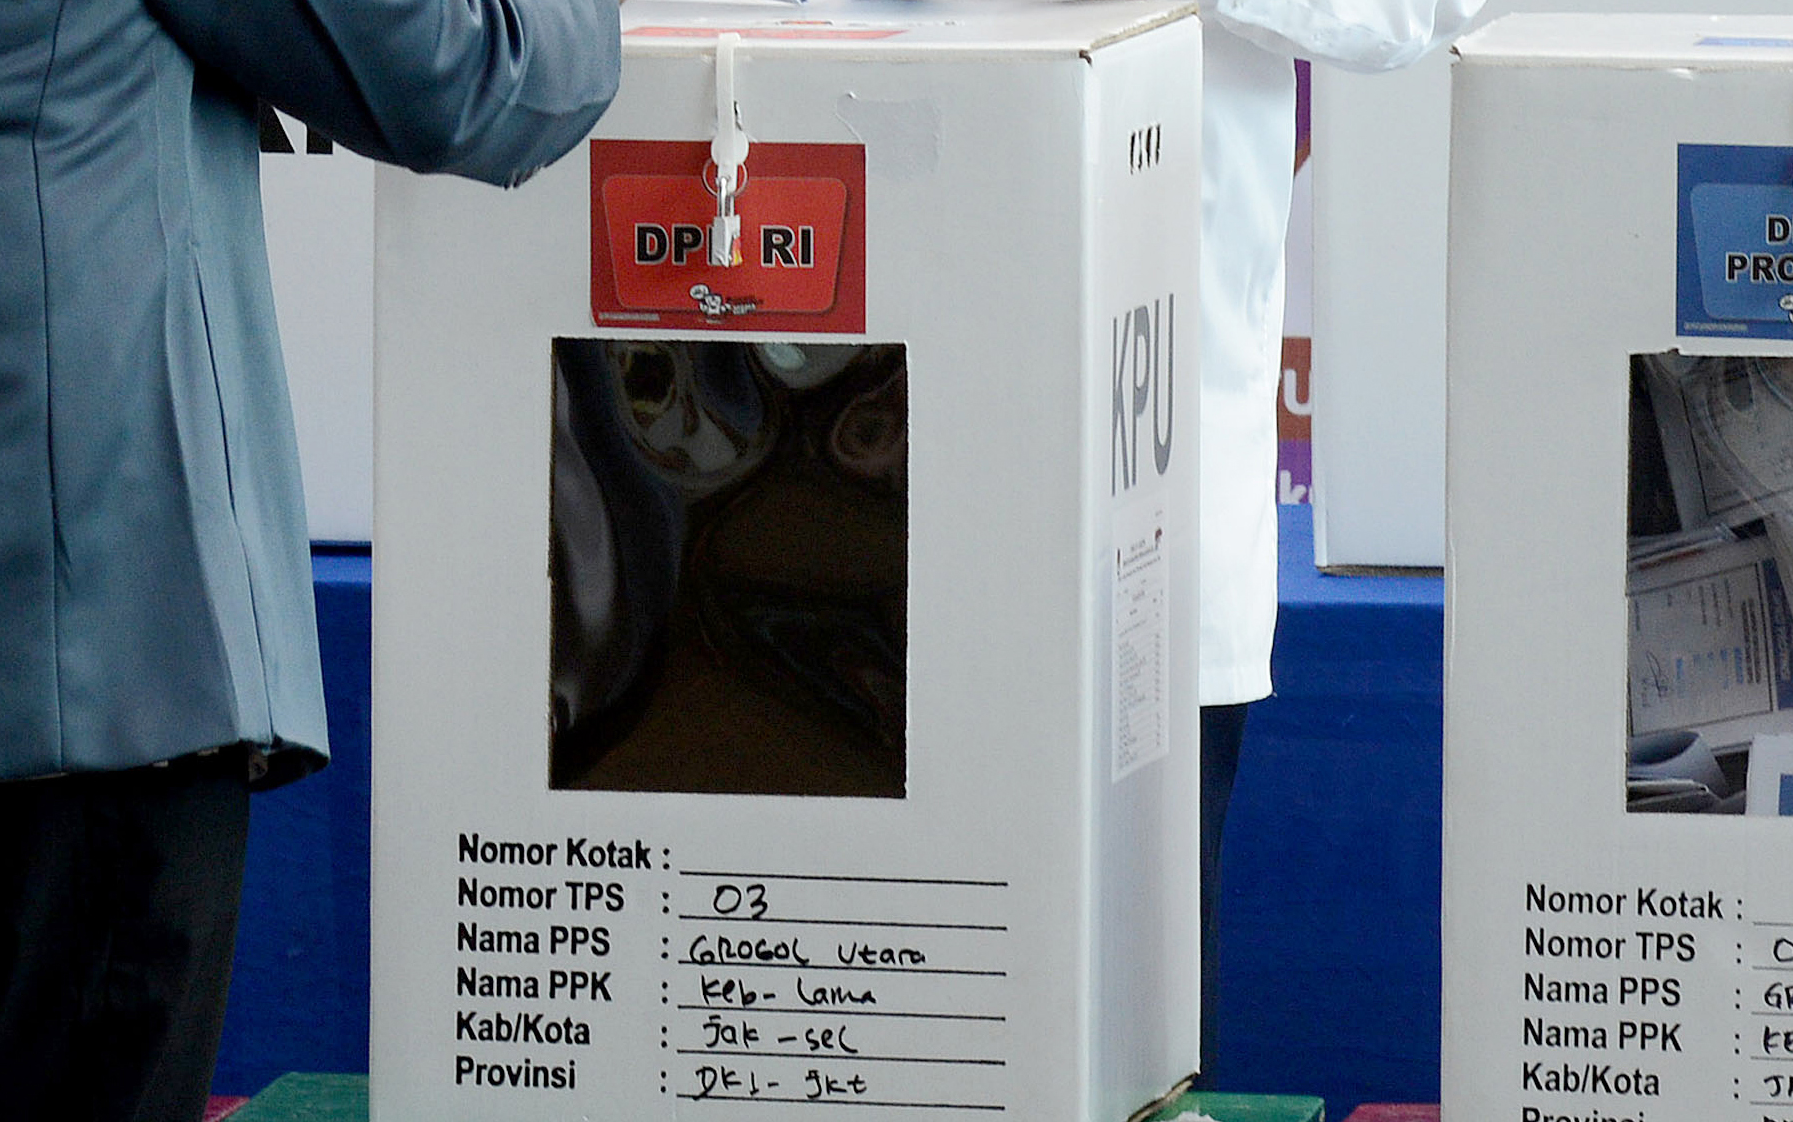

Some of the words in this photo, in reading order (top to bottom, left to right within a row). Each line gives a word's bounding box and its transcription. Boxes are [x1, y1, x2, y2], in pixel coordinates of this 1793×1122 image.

[635, 223, 741, 265] DP
[760, 225, 814, 267] RI
[1112, 293, 1174, 497] KPU
[459, 833, 558, 866] Nomor
[567, 838, 651, 869] Kotak
[459, 877, 557, 910] Nomor
[565, 881, 624, 912] TPS
[713, 884, 768, 919] 03
[1527, 884, 1626, 915] Nomor
[1638, 888, 1723, 919] Kotak
[458, 922, 539, 954] Nama
[551, 926, 610, 956] PPS
[1526, 928, 1626, 959] Nomor
[1636, 932, 1695, 962] TPS
[457, 967, 539, 998] Nama
[549, 970, 611, 1001] PPK
[1525, 973, 1607, 1004] Nama
[1620, 977, 1680, 1006] PPS
[457, 1011, 590, 1045] Kab/Kota
[1524, 1018, 1606, 1049] Nama
[1620, 1021, 1681, 1051] PPK
[456, 1055, 575, 1089] Provinsi
[1523, 1062, 1659, 1096] Kab/Kota
